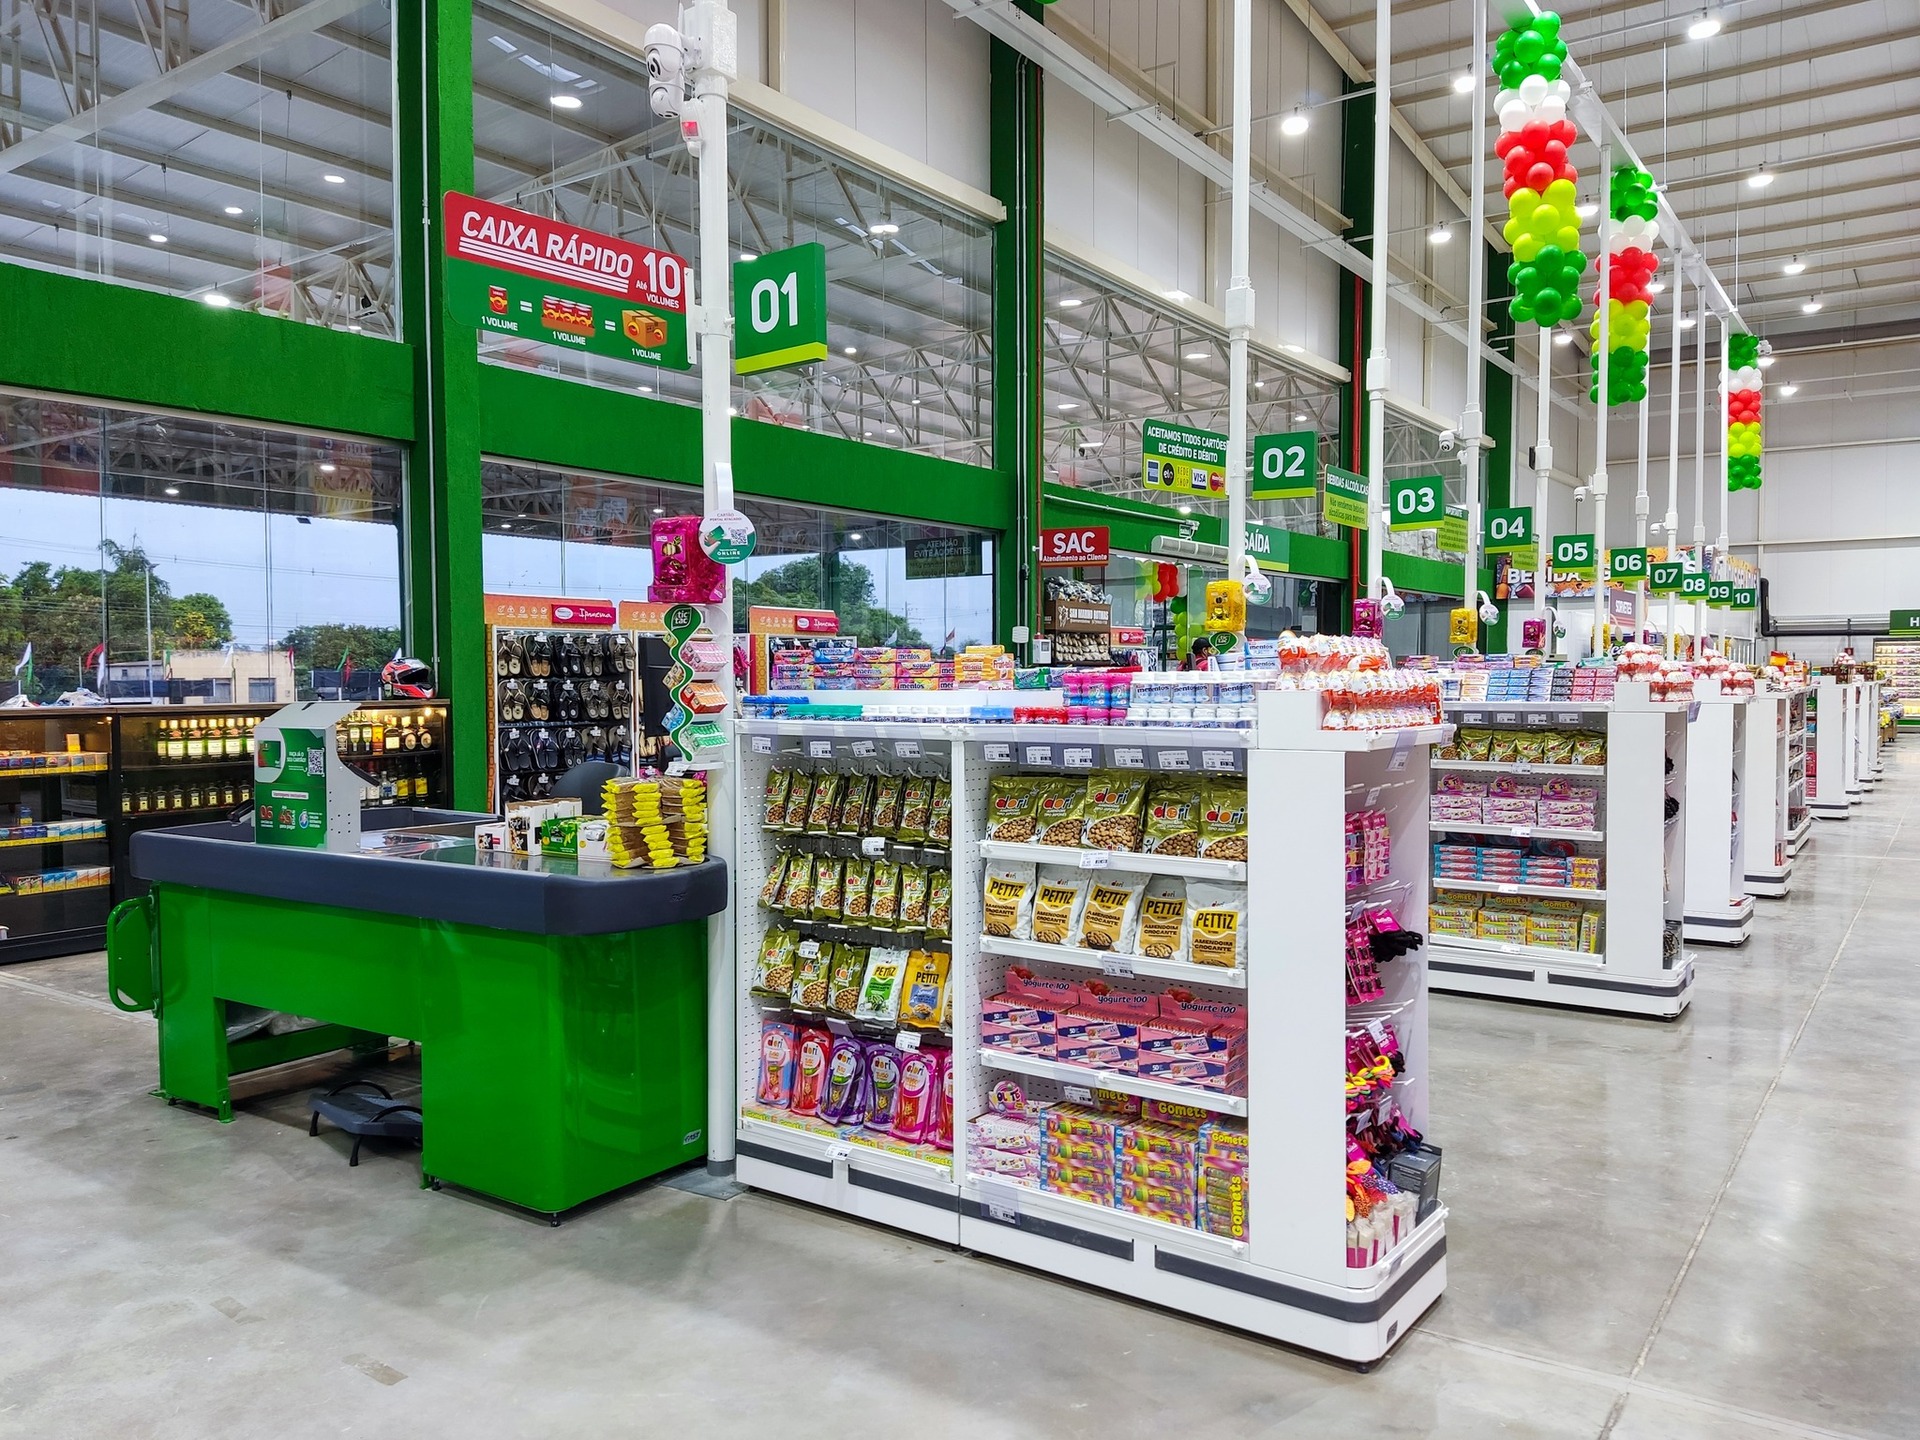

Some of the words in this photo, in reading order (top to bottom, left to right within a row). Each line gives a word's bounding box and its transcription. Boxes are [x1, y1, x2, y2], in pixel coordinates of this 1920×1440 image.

[461, 210, 539, 254] CAIXA
[545, 234, 635, 278] RÁPIDO
[643, 251, 681, 299] 10
[636, 279, 648, 290] Até
[646, 292, 680, 310] VOLUMES
[750, 271, 799, 334] 01
[481, 316, 486, 325] 1
[486, 317, 519, 333] VOLUME
[552, 331, 557, 341] 1
[557, 332, 587, 346] VOLUME
[631, 347, 636, 356] 1
[636, 348, 662, 361] VOLUME
[1147, 426, 1181, 442] ACEITAMOS
[1182, 433, 1201, 446] TODOS
[1201, 437, 1227, 451] CARTÕES
[1158, 442, 1167, 453] DE
[1167, 443, 1193, 458] CRÉDITO
[1193, 449, 1197, 459] E
[1197, 448, 1218, 463] DÉBITO
[1262, 446, 1305, 479] 02
[1193, 472, 1206, 483] VISA
[1327, 473, 1345, 488] BEBIDAS
[1397, 487, 1435, 515] 03
[1491, 516, 1525, 539] 04
[1053, 531, 1096, 554] SAC
[1043, 554, 1079, 563] Atendimento
[1087, 553, 1107, 561] Cliente
[1558, 542, 1588, 562] 05
[1614, 554, 1642, 571] 06
[1654, 568, 1679, 584] 07
[1683, 578, 1706, 592] 08
[1709, 586, 1730, 599] 09
[1735, 592, 1750, 604] 10
[674, 616, 688, 624] tac
[677, 609, 689, 618] tic
[995, 794, 1029, 809] dori
[1043, 793, 1076, 809] dori
[1094, 788, 1131, 804] dori
[1153, 802, 1191, 820] dori
[1206, 806, 1245, 825] dori
[1446, 892, 1477, 901] Gomets
[1495, 896, 1527, 905] Gomets
[985, 908, 1014, 916] CROCANTE
[1542, 900, 1576, 909] Gomets
[1036, 911, 1068, 919] AMENDOIM
[1036, 915, 1067, 924] CROCANTE
[1085, 915, 1119, 926] CROCANTE
[1087, 910, 1121, 921] AMENDOIM
[1194, 944, 1232, 952] CROCANTE
[1023, 979, 1054, 989] Yogurte
[1055, 982, 1070, 990] 100
[1097, 994, 1132, 1004] Yogurte
[1133, 995, 1148, 1003] 100
[1180, 1002, 1218, 1013] Yogurte
[1220, 1005, 1237, 1014] 100
[767, 1034, 783, 1050] dori
[803, 1042, 818, 1056] dori
[836, 1050, 853, 1065] dori
[874, 1057, 891, 1071] dori
[906, 1061, 925, 1075] dori
[1158, 1102, 1208, 1119] Gomets
[1211, 1132, 1248, 1147] Gomets
[1230, 1176, 1244, 1237] Gomets
